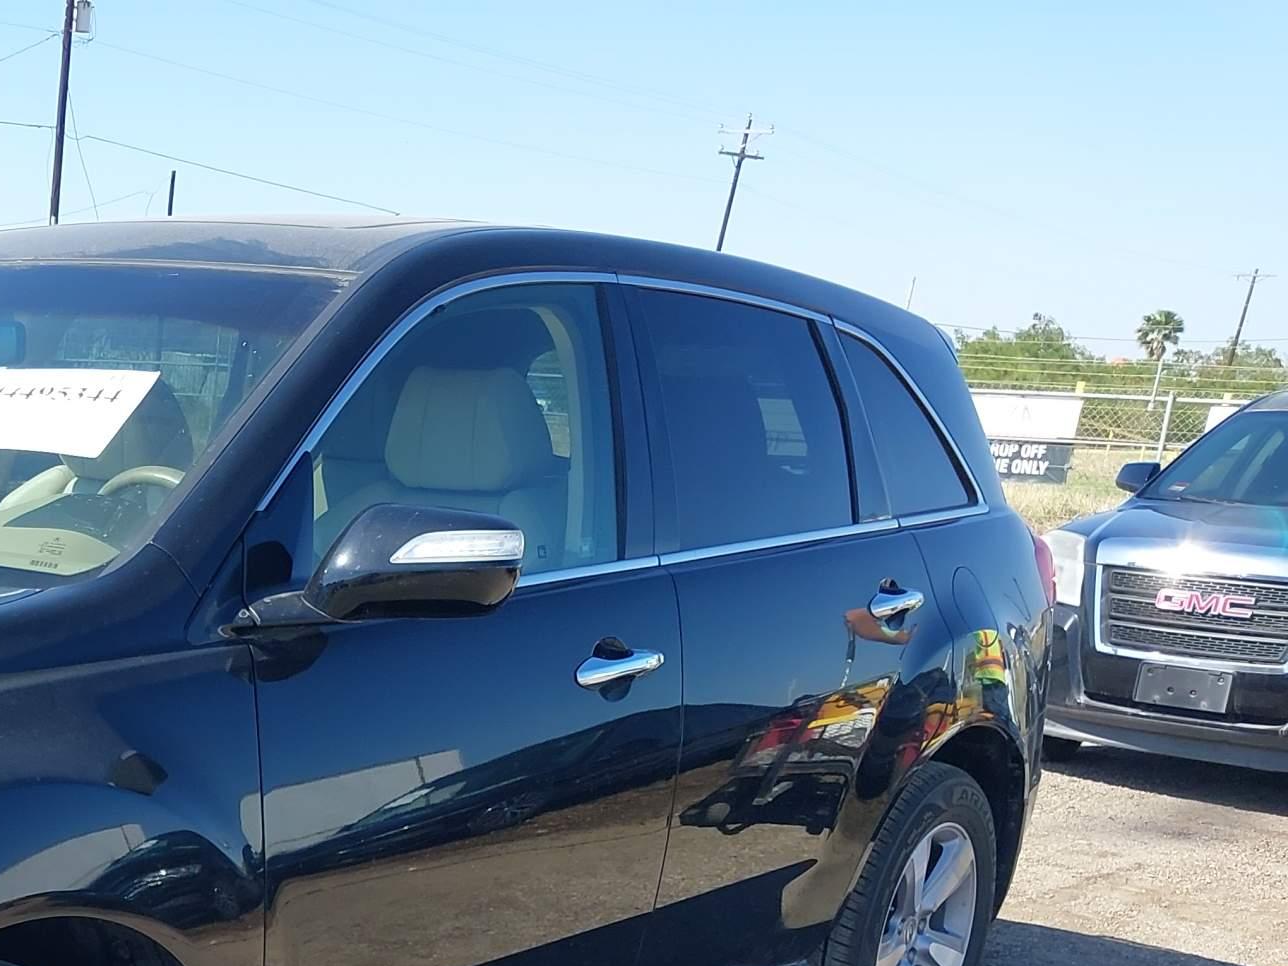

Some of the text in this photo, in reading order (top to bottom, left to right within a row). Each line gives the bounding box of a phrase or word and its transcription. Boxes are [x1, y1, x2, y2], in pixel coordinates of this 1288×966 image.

[1021, 444, 1047, 459] OFF
[1011, 459, 1049, 475] ONLY
[1155, 588, 1256, 619] GMC
